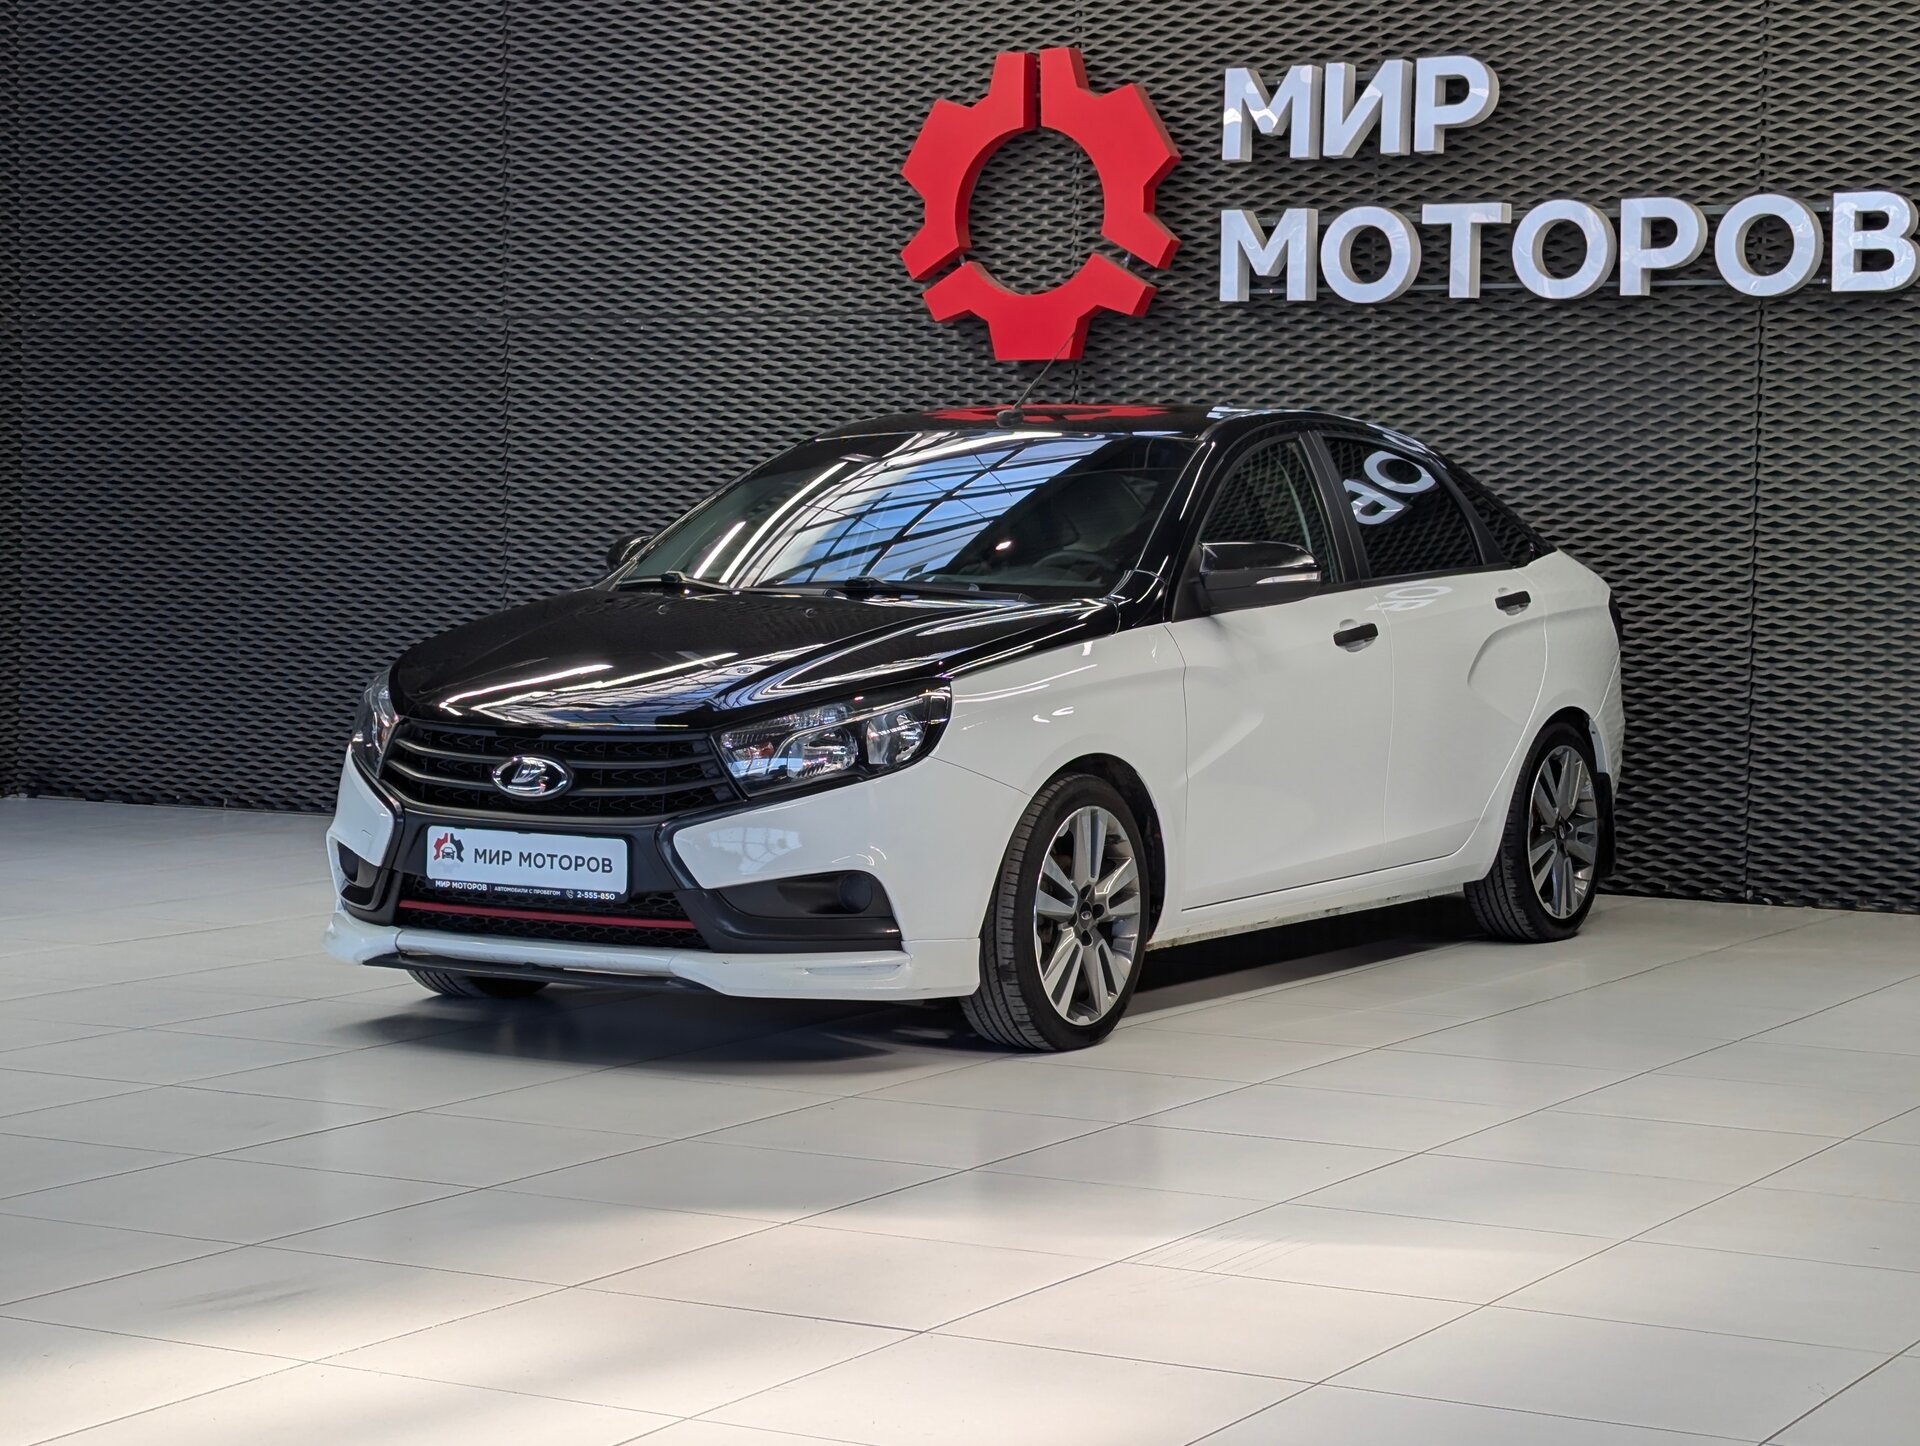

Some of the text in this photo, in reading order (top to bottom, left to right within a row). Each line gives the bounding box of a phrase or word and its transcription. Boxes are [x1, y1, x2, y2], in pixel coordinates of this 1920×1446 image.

[1221, 55, 1499, 162] МИР
[1219, 190, 1920, 303] МОТОРОВ
[474, 848, 613, 874] МИР МОТОРОВ
[435, 880, 488, 891] МИР МОТОРОВ
[494, 886, 528, 894] АВТОМОБИЛИ
[576, 890, 616, 900] 2-555-850
